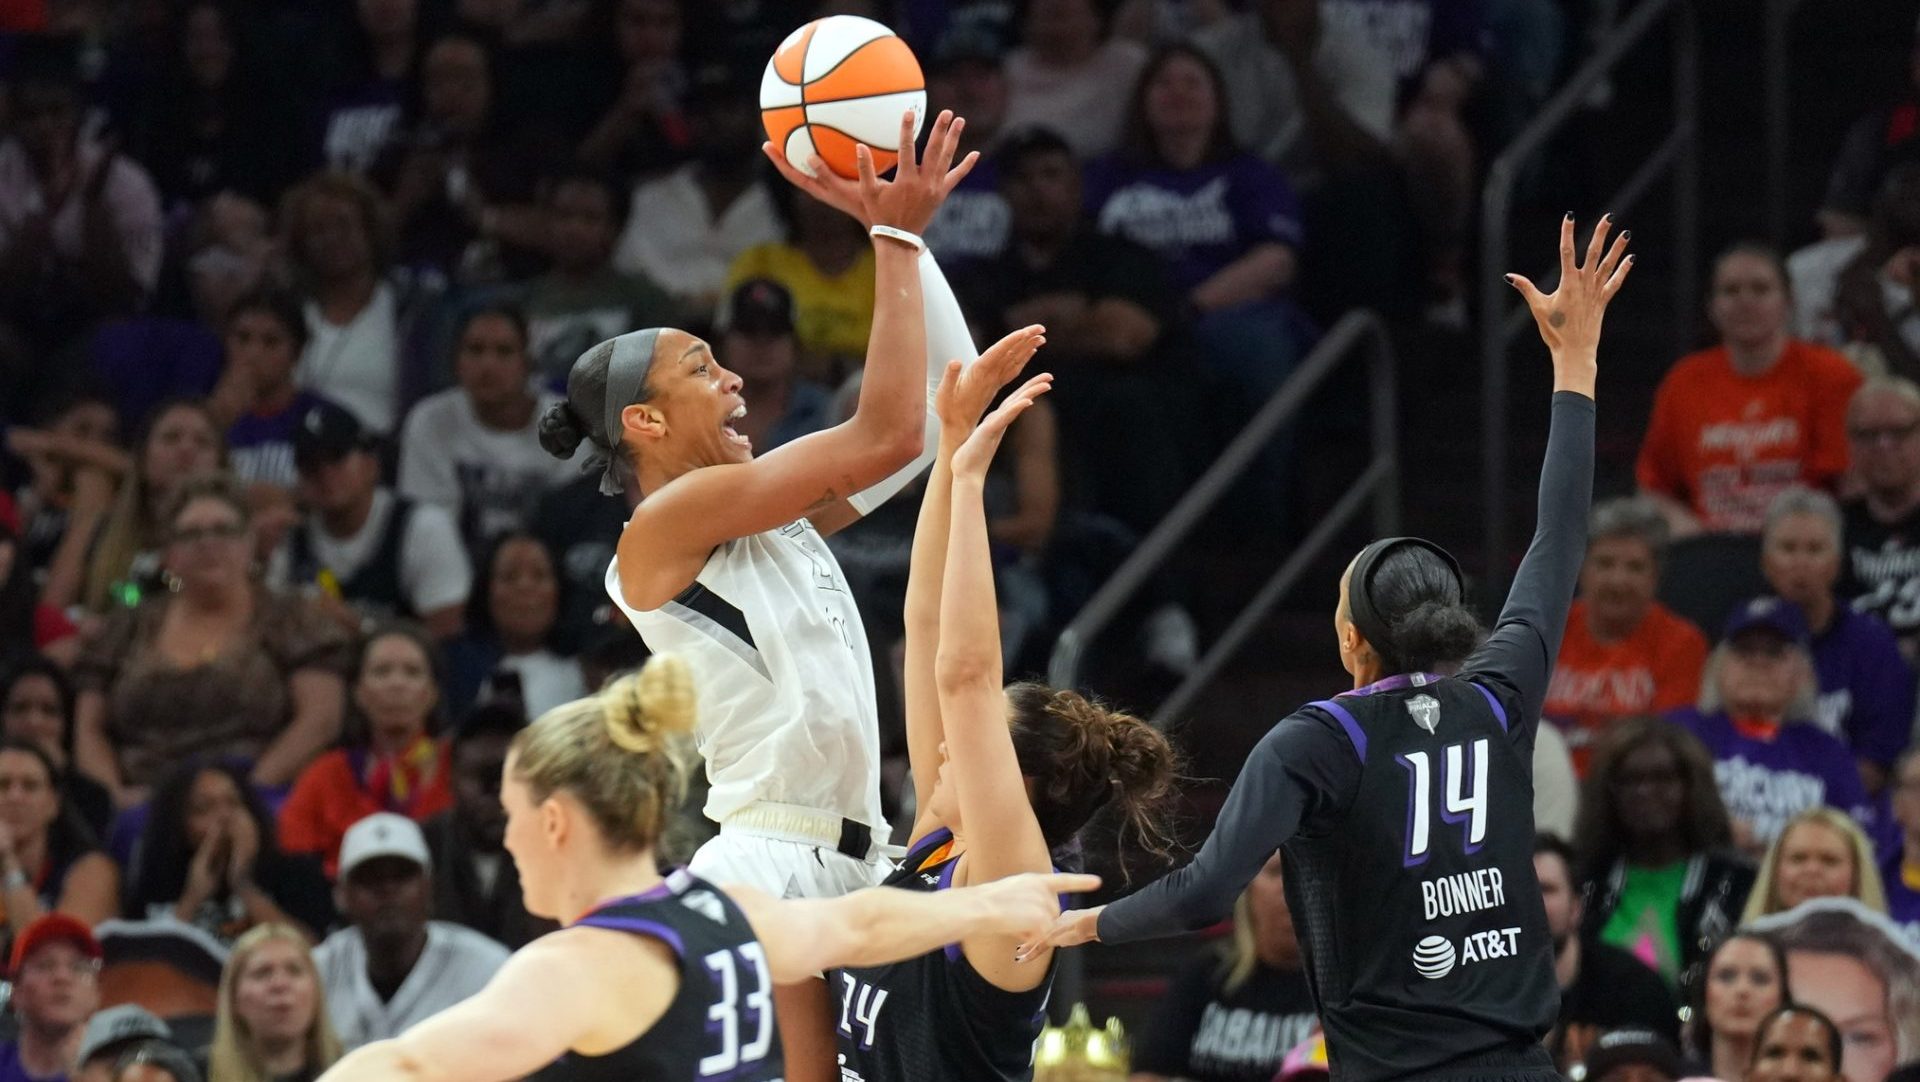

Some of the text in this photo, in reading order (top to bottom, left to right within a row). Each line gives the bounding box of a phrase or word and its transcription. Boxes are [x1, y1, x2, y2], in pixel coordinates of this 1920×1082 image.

[1399, 738, 1489, 861] 14
[1421, 867, 1505, 921] BONNER
[1461, 927, 1522, 966] AT&T
[698, 940, 774, 1077] 33
[840, 971, 889, 1047] 24
